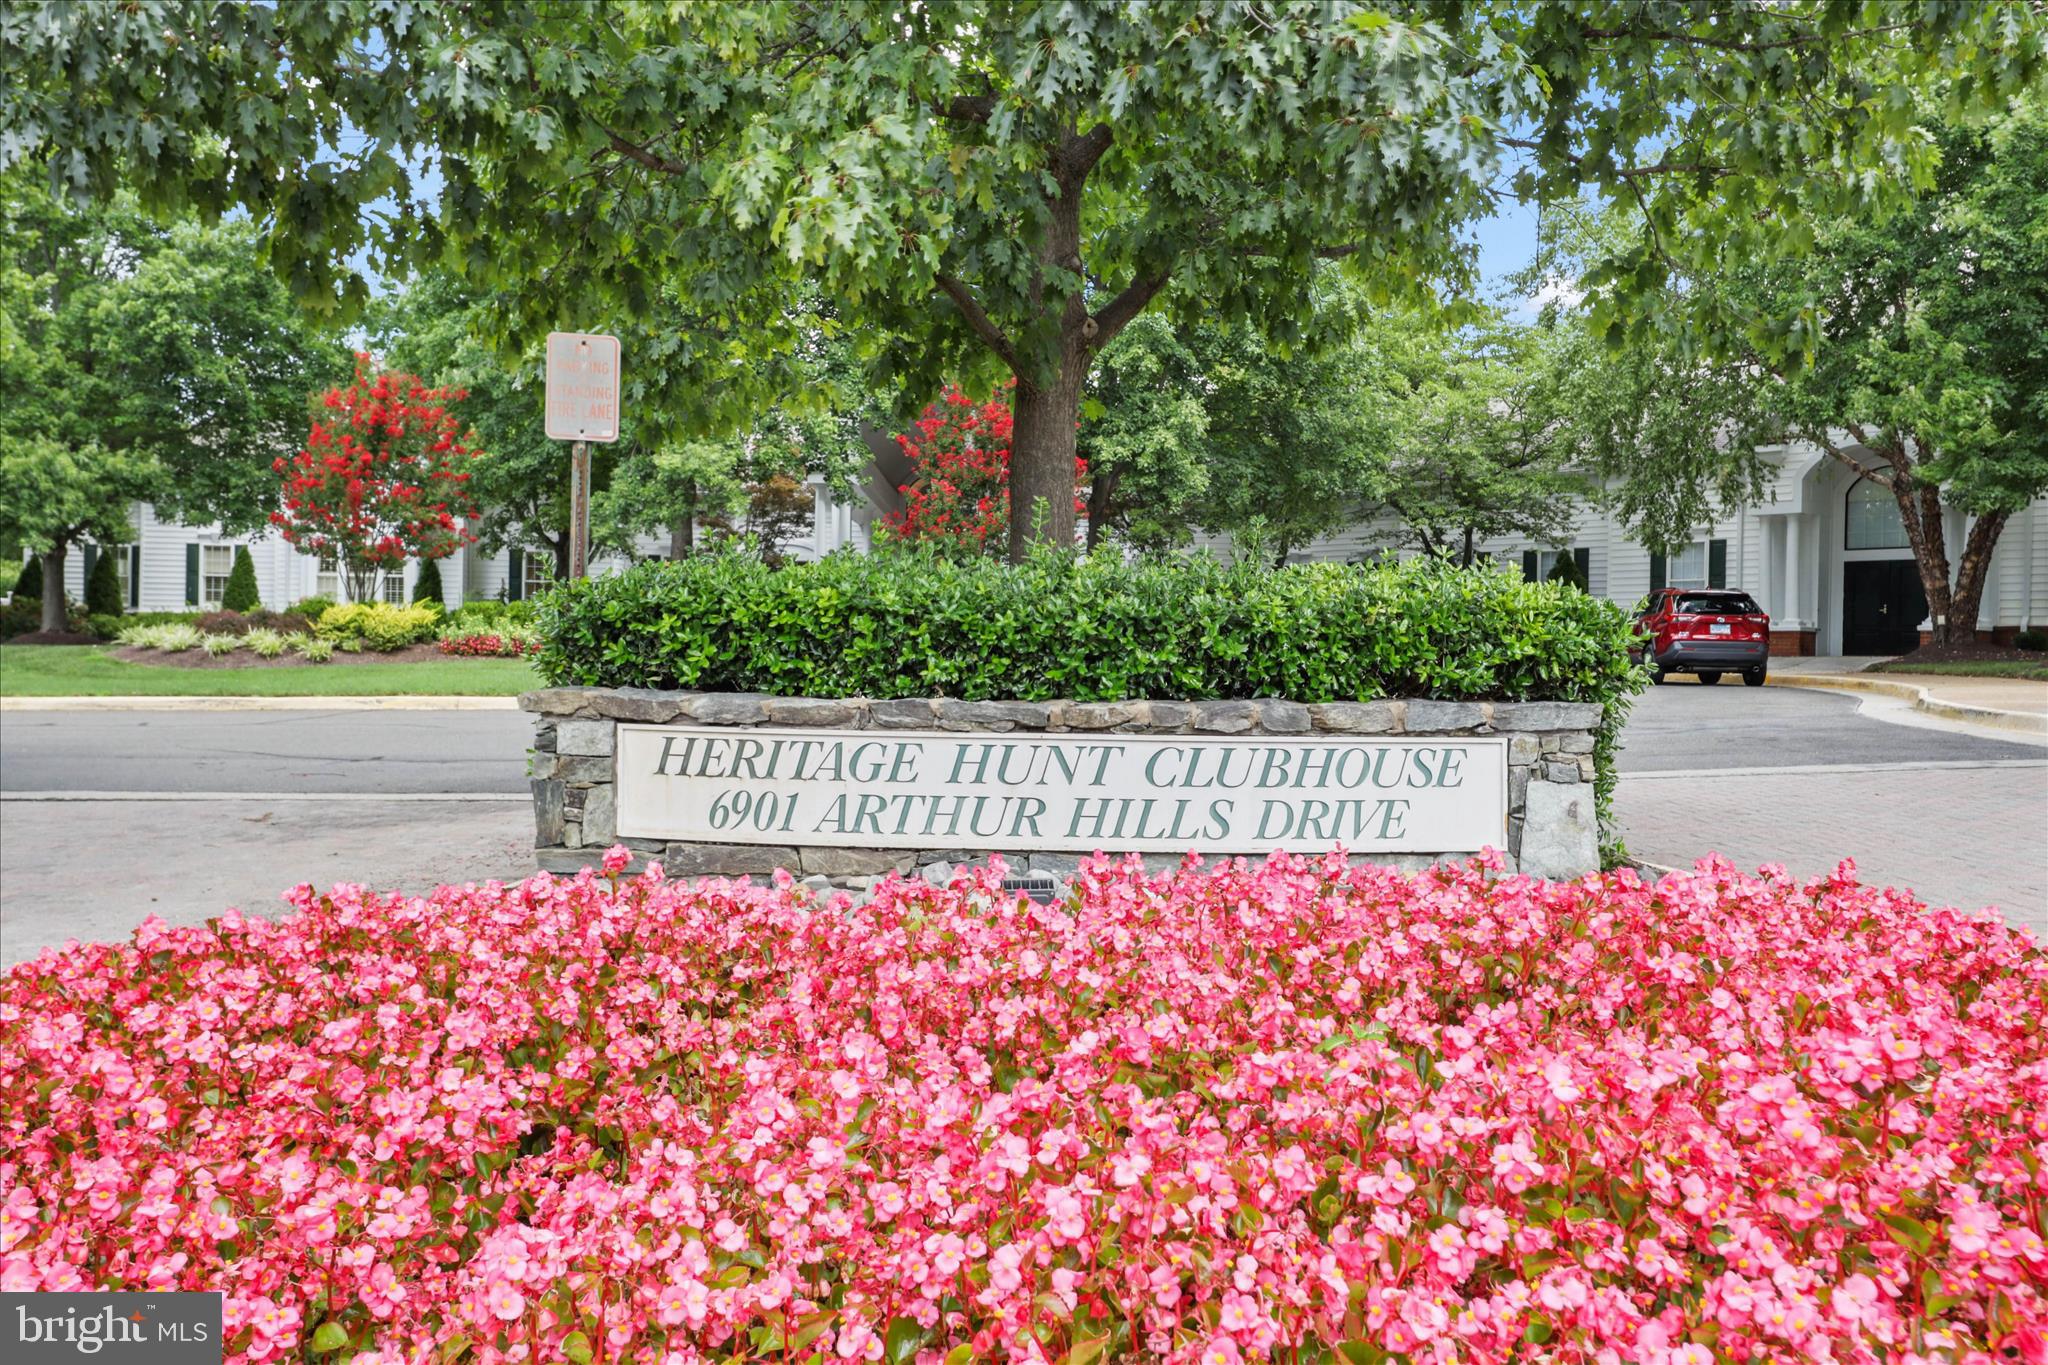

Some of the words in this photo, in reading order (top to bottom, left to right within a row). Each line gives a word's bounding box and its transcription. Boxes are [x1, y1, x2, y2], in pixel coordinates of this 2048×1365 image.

[653, 736, 924, 783] HERITAGE
[945, 743, 1126, 786] HUNT
[1144, 747, 1468, 788] CLUBHOUSE
[708, 789, 800, 832] 6901
[811, 793, 1047, 838] ARTHUR
[1063, 797, 1235, 841] HILLS
[1251, 799, 1411, 841] DRIVE
